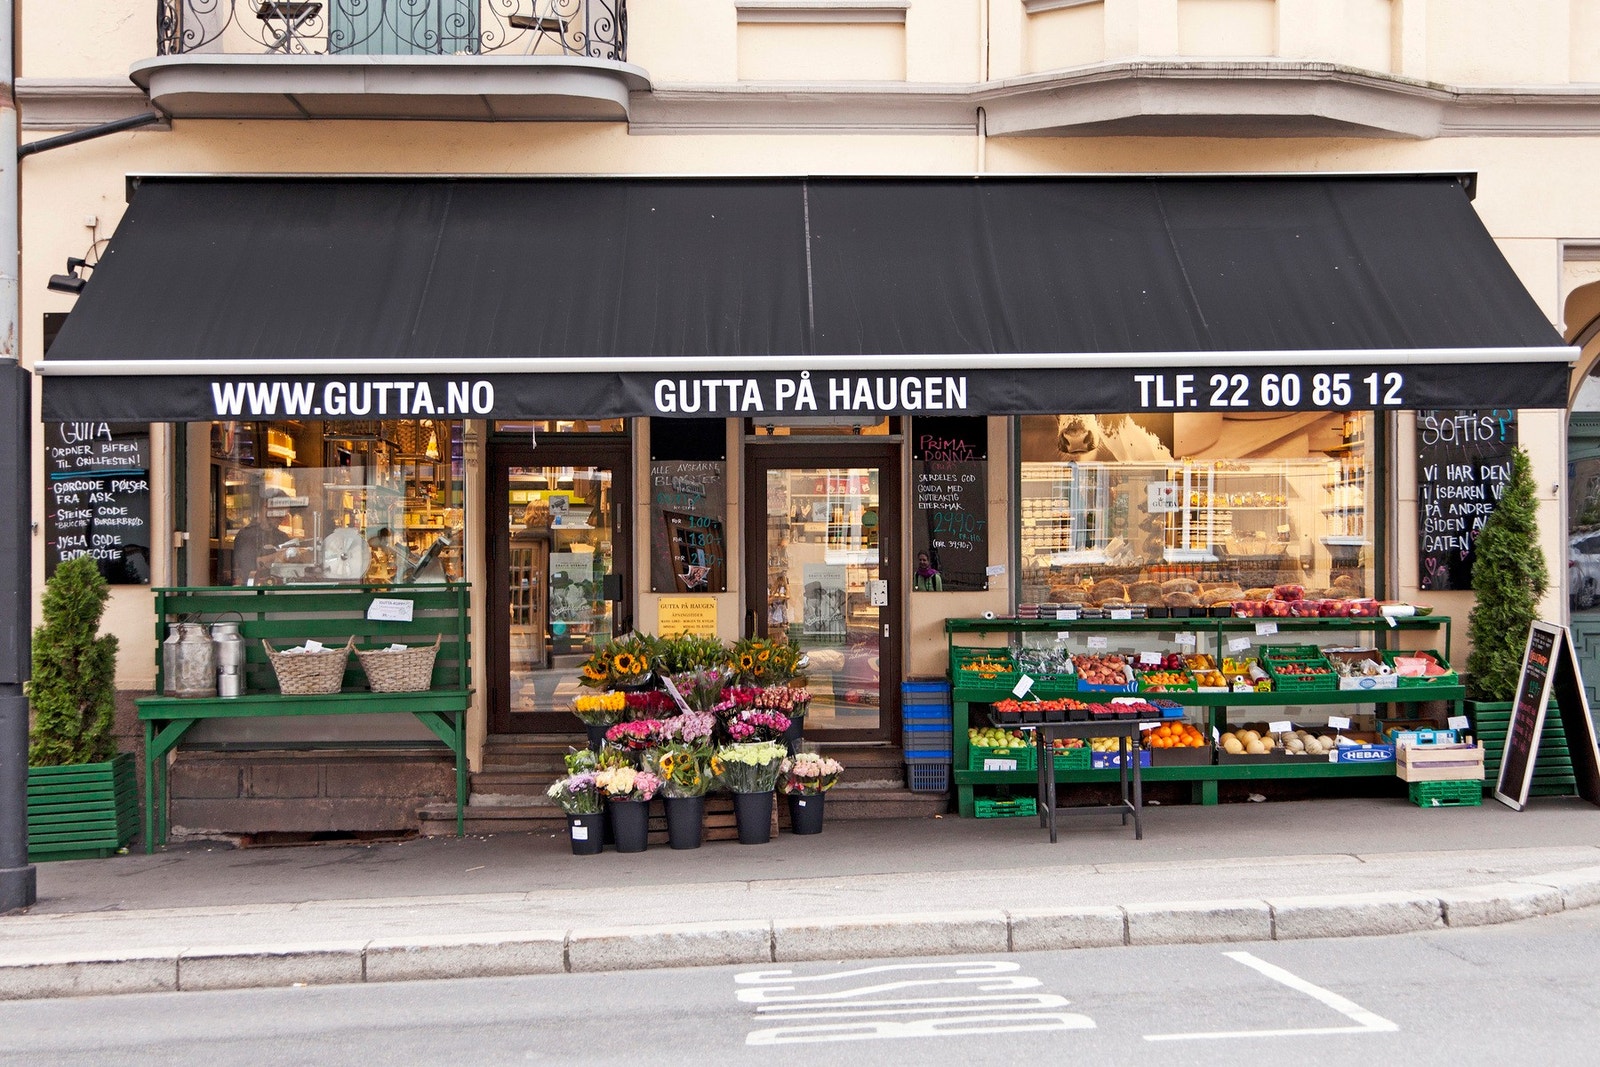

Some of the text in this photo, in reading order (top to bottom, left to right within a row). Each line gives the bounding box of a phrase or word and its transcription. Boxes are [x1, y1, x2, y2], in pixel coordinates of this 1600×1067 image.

[653, 370, 968, 413] GUTTA PÅ HAUGEN
[1134, 371, 1403, 408] TLF. 22 60 85 12
[211, 380, 495, 416] WWW.GUTTA.NO
[51, 442, 139, 458] ORDNER BIFFEN
[920, 434, 977, 452] PRIMA
[55, 454, 141, 469] TIL GRILLFESTEN!
[924, 449, 983, 463] DONNA
[651, 465, 670, 475] ALLE
[961, 474, 976, 482] GOD
[1423, 461, 1512, 482] VI HAR DEN
[112, 480, 150, 494] PØLSER
[917, 484, 963, 493] GOUDA MED
[1436, 484, 1485, 500] ISBAREN
[56, 492, 116, 504] FRA ASK
[57, 506, 128, 520] STEIKE GODE
[1425, 500, 1495, 518] PÅ ANDRE
[1424, 515, 1488, 533] SIDEN AV
[56, 534, 122, 550] JYSLA GODE
[1424, 531, 1470, 553] GATEN
[1347, 751, 1389, 759] HEBAL
[734, 960, 1098, 1047] BUSS
